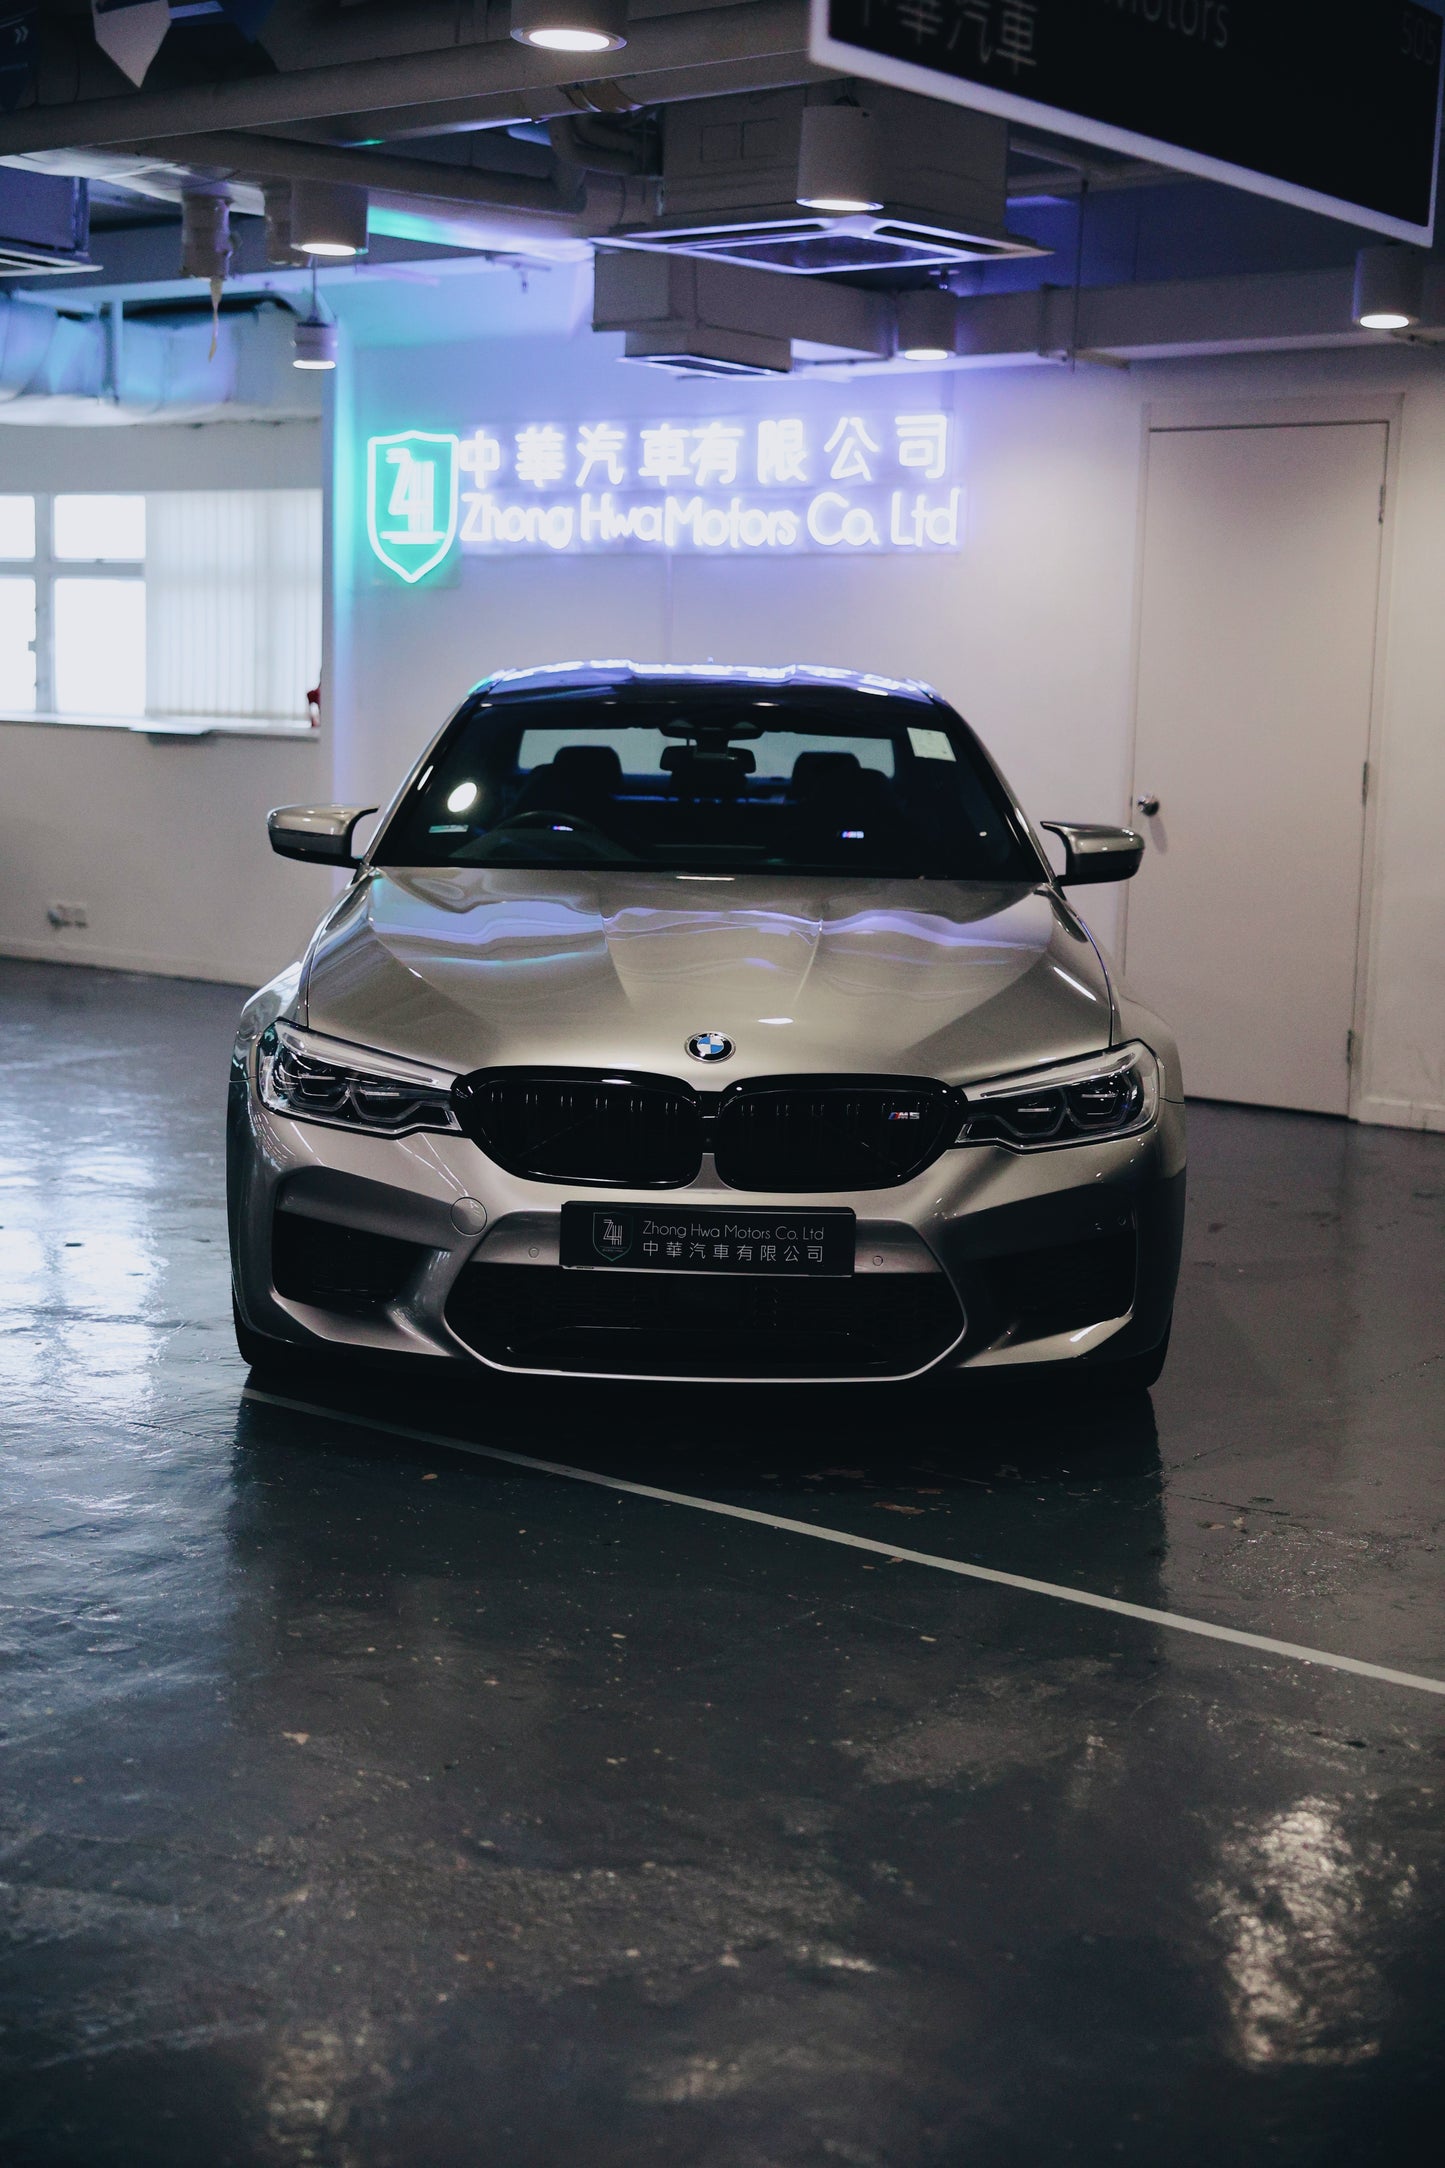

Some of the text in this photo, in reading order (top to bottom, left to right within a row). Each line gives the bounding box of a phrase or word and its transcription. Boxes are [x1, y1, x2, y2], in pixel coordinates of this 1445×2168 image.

[459, 413, 949, 488] 中華汽車有限公司
[460, 492, 573, 549] Zhong
[580, 492, 662, 542] Hwa
[664, 495, 799, 548] Motors
[891, 487, 960, 547] Ltd
[642, 1220, 825, 1242] Zhong Hwa Motors Co. Ltd
[642, 1240, 824, 1263] 中華汽車有限公司
